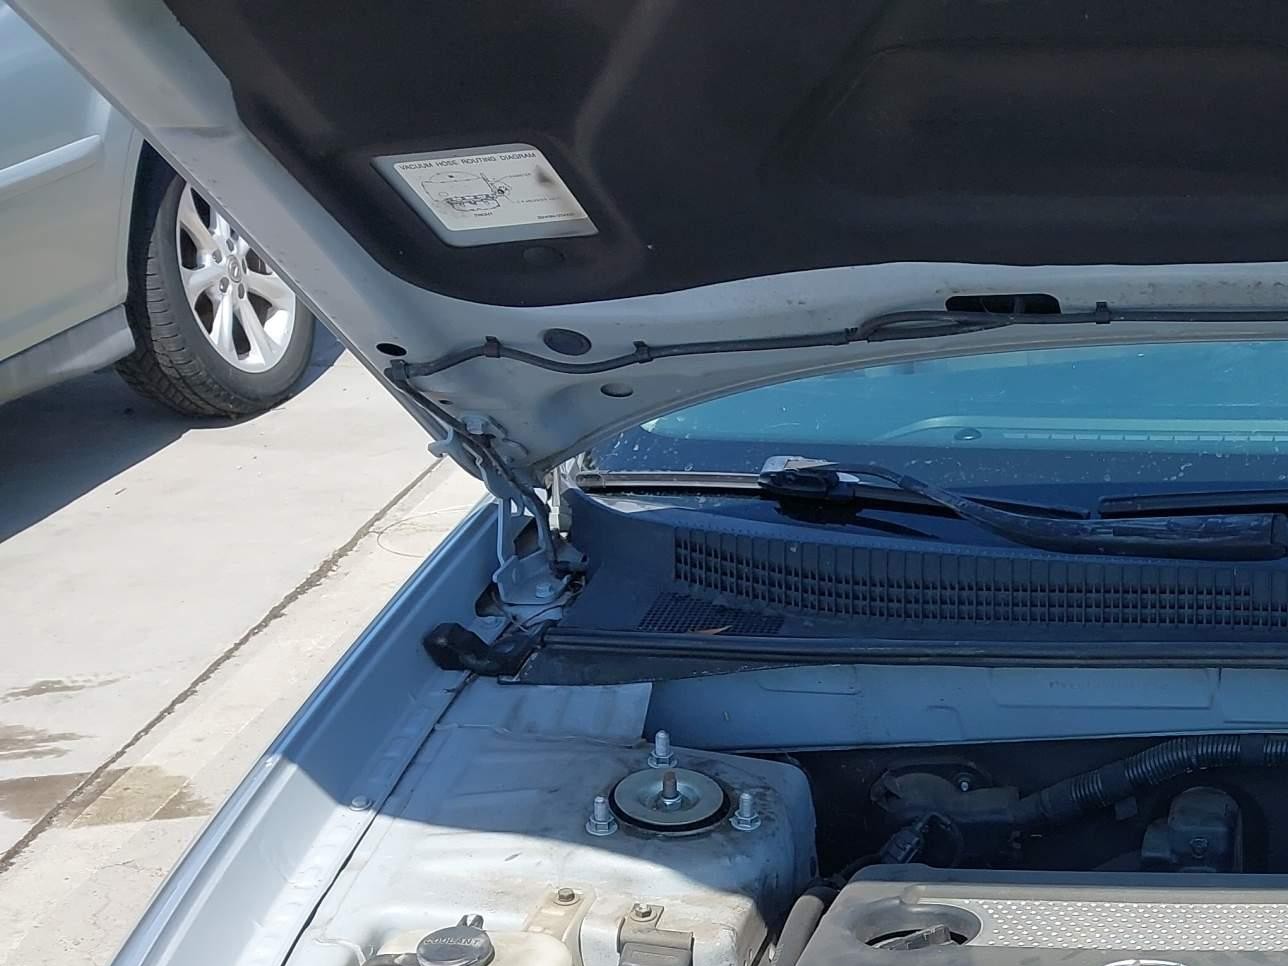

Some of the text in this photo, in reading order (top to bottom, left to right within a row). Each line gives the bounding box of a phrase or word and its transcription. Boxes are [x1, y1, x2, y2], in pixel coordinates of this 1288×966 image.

[399, 152, 537, 170] VACUUM HOSE ROUTING DIAGRAM
[424, 936, 481, 946] COOLANT
